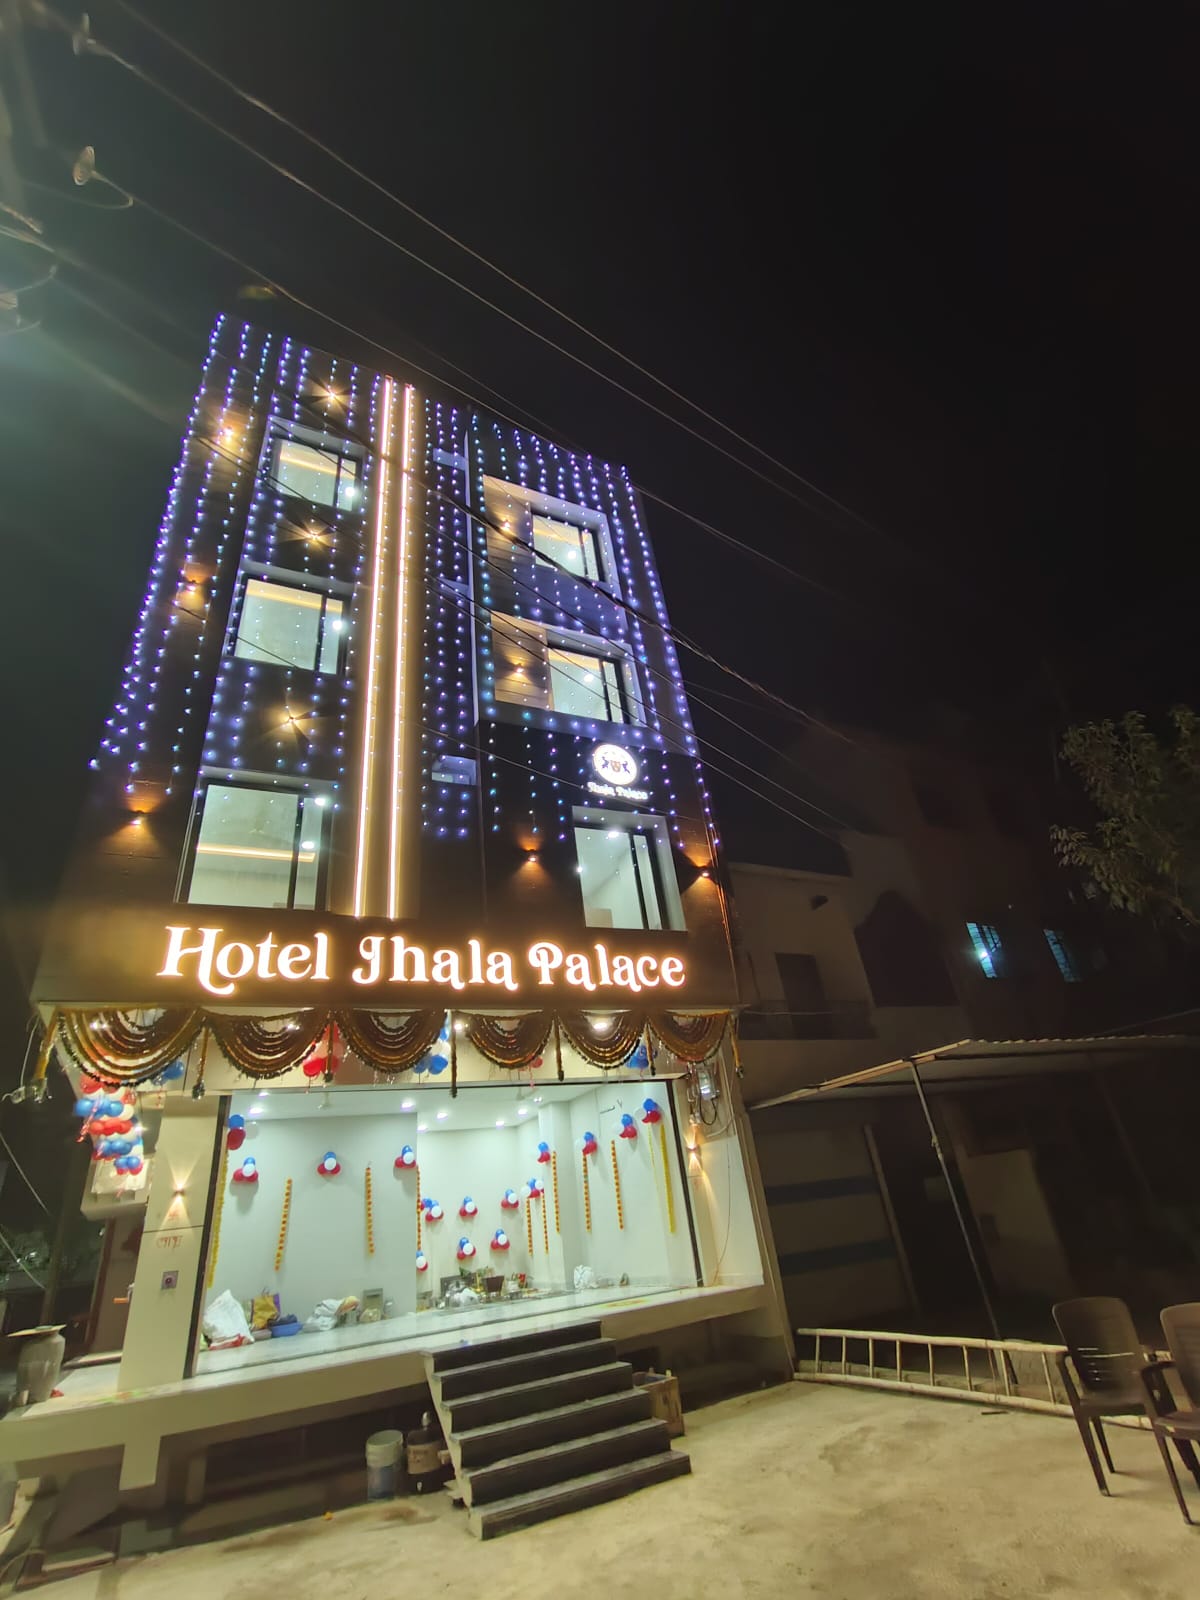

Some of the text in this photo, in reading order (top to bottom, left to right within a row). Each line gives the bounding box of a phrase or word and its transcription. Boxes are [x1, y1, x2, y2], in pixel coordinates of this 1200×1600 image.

[156, 925, 686, 996] Hotel Jhala Palace
